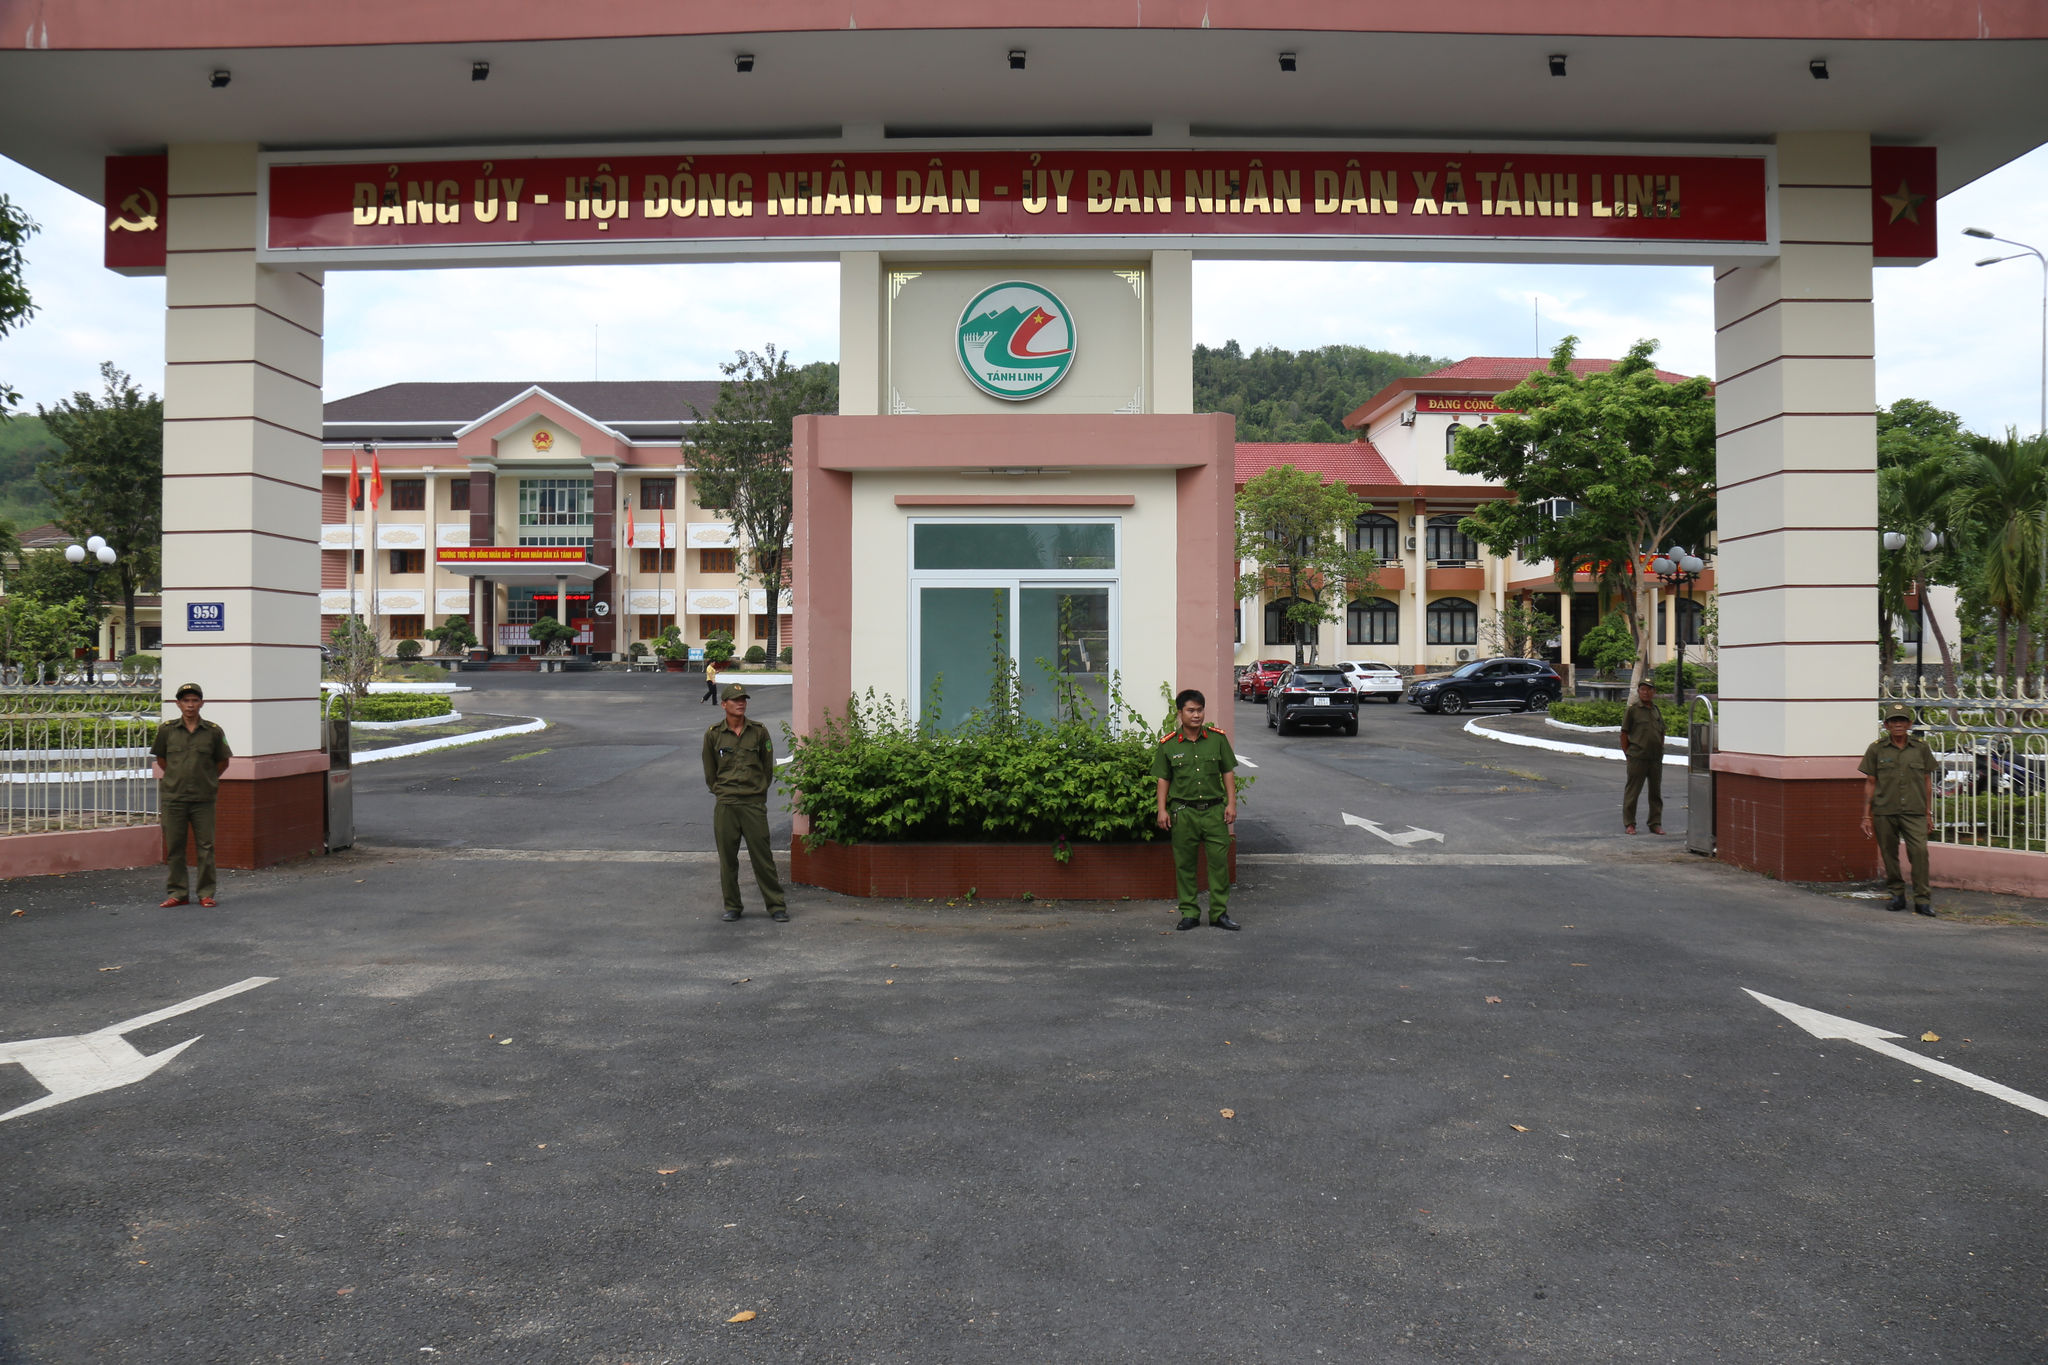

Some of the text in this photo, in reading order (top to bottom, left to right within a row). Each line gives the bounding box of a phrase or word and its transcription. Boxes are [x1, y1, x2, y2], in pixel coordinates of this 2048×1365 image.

[352, 153, 1681, 230] ĐẢNG ỦY - HỘI ĐỒNG NHÂN DÂN - ỦY BAN NHÂN DÂN XÃ TÁNH LINH
[986, 370, 1043, 381] TÁNH LINH
[1428, 397, 1460, 409] ĐẢNG
[1464, 398, 1496, 411] CỘNG
[193, 605, 218, 619] 959
